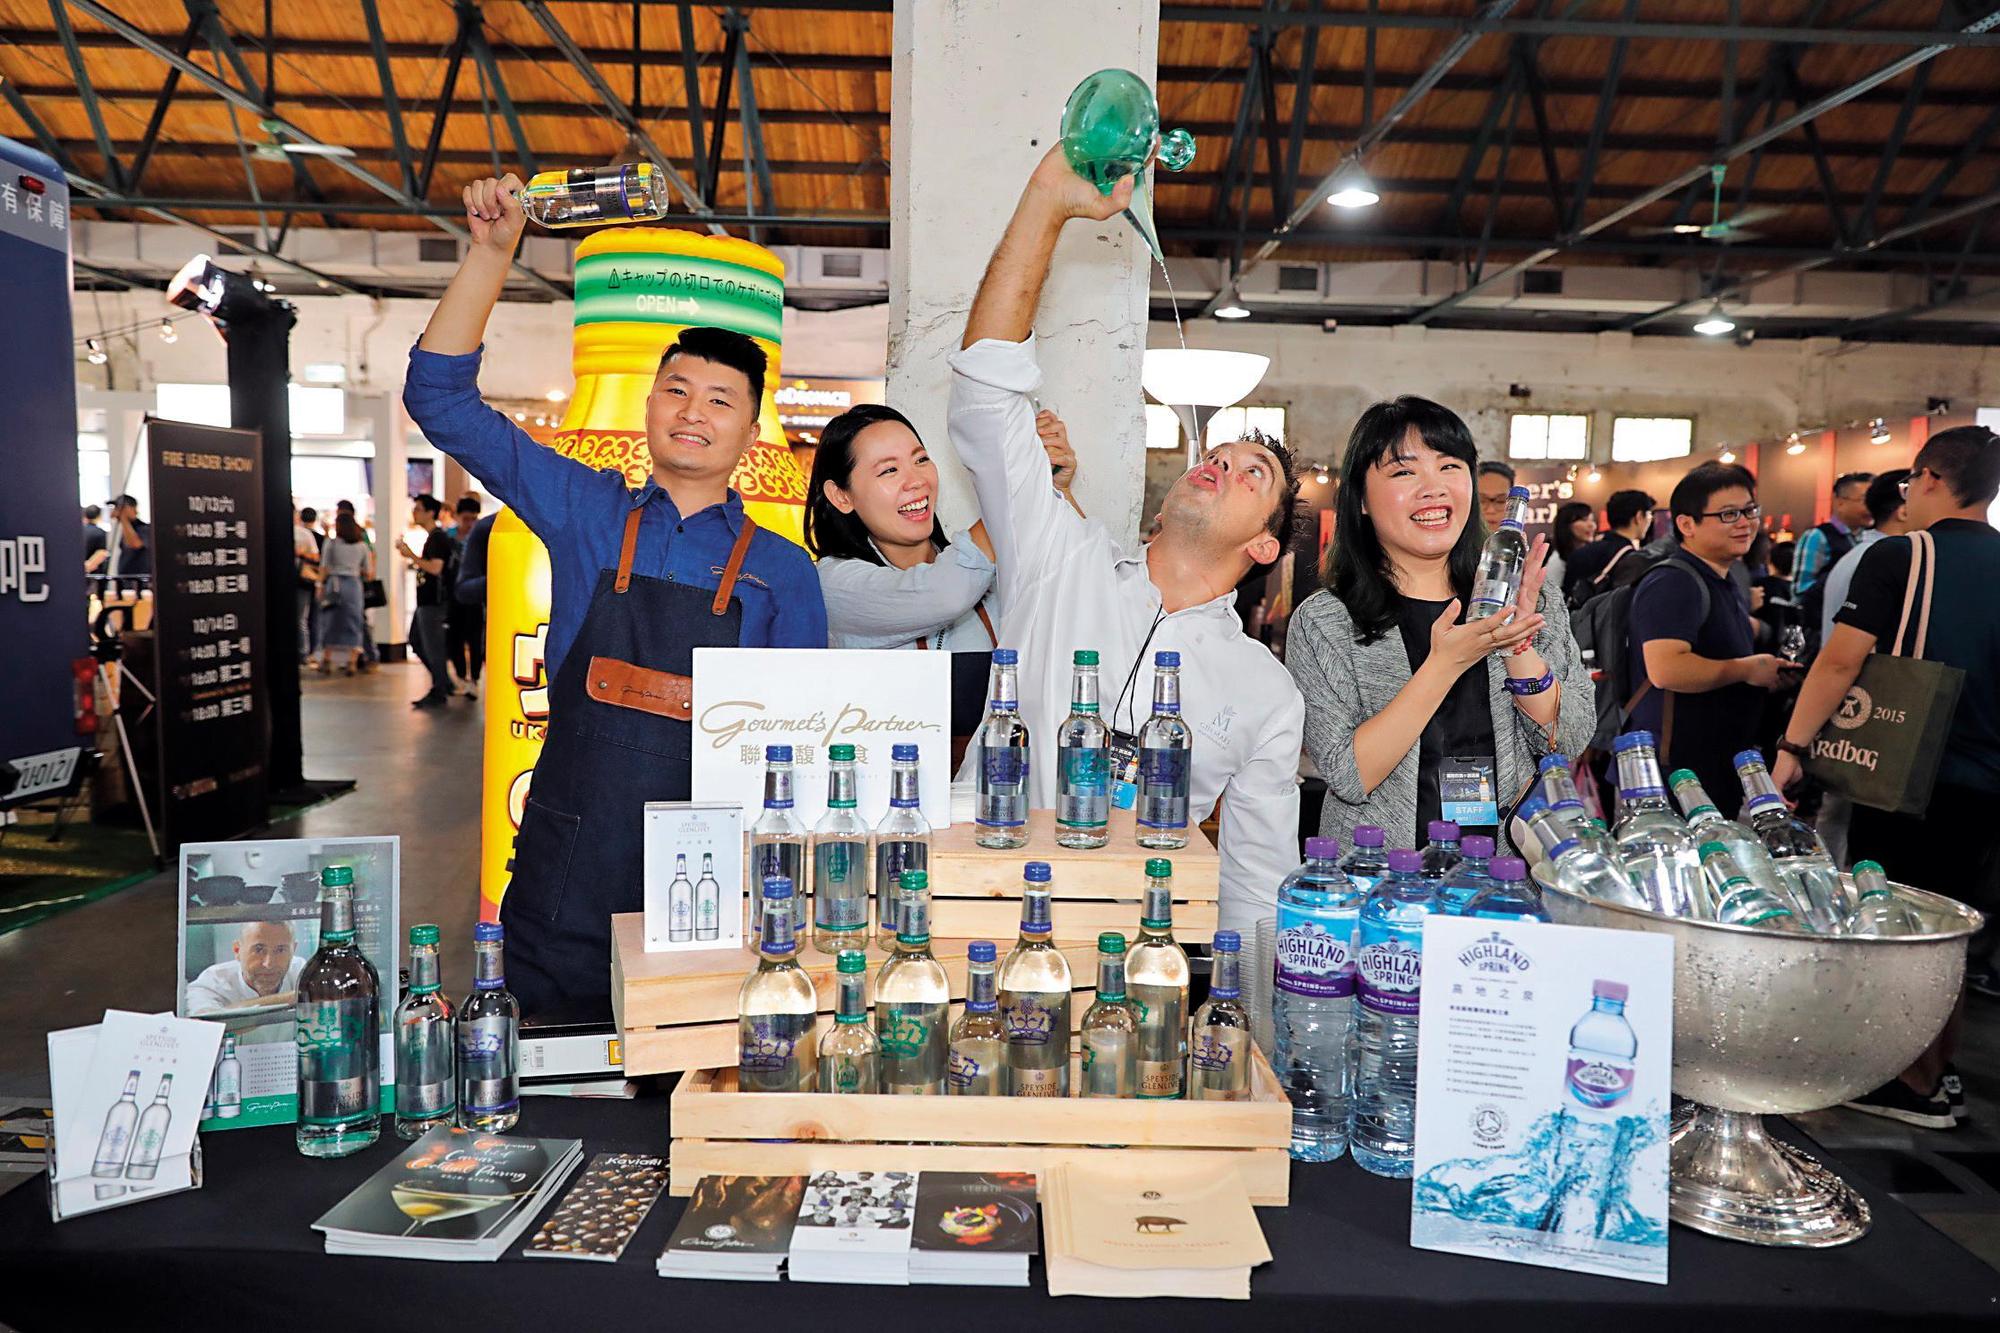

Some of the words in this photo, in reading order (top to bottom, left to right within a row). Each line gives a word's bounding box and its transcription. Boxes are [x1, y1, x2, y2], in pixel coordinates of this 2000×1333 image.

[1, 182, 65, 231] 有保障
[635, 295, 679, 314] OPEN
[186, 453, 221, 470] LEADER
[223, 456, 253, 472] SHOW
[1526, 480, 1574, 499] er's
[1873, 706, 1906, 724] 2015
[700, 701, 826, 749] Gourmet's
[821, 703, 941, 748] Partner
[740, 744, 869, 765] 聯馥食
[1456, 806, 1485, 814] STAFF
[1278, 938, 1345, 963] HIGHLAND
[1458, 944, 1530, 971] HIGHLAND
[1289, 954, 1327, 968] SPRING
[1362, 954, 1420, 976] HIGHLAN
[1374, 970, 1414, 985] SPRING
[1020, 1082, 1056, 1090] SPEYSIDE
[1145, 1072, 1180, 1082] SPEYSIDE
